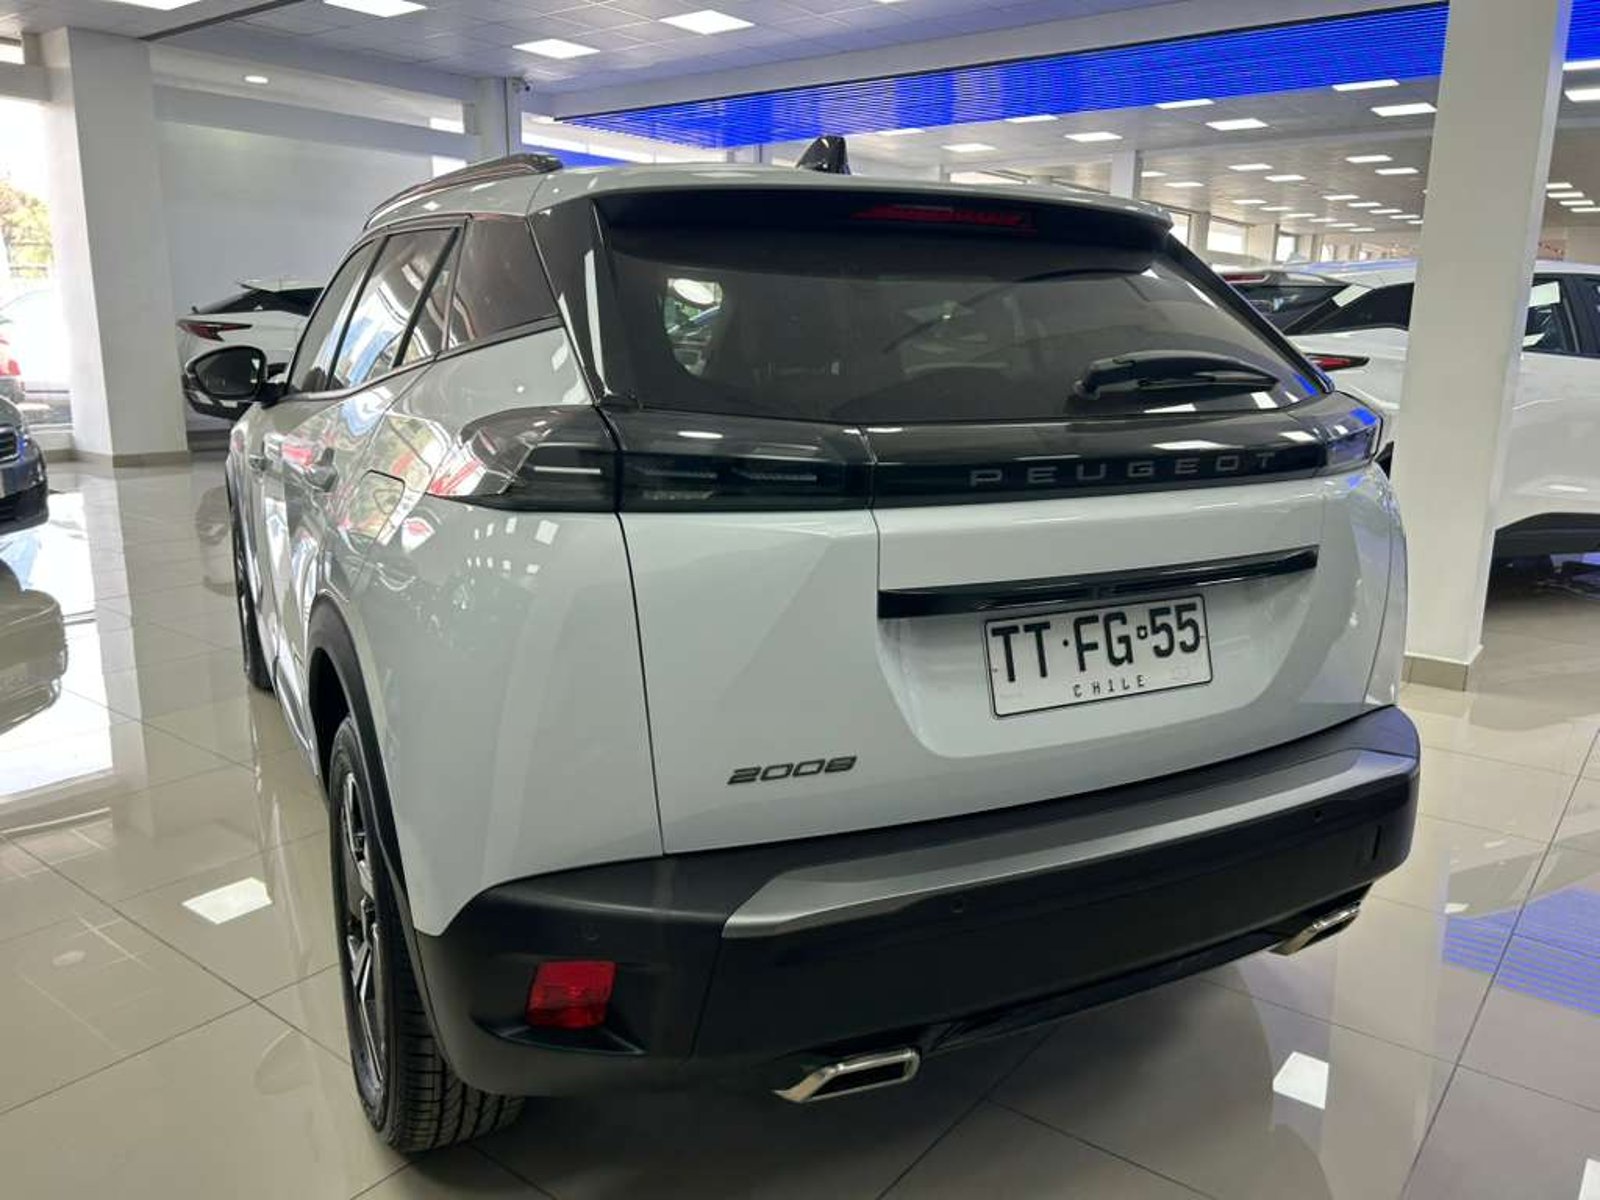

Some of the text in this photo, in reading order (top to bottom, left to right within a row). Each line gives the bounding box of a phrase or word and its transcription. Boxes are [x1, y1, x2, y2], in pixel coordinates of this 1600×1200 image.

[969, 452, 1275, 487] PEUGEOT
[1072, 674, 1150, 698] CHILE
[727, 755, 858, 785] 2008
